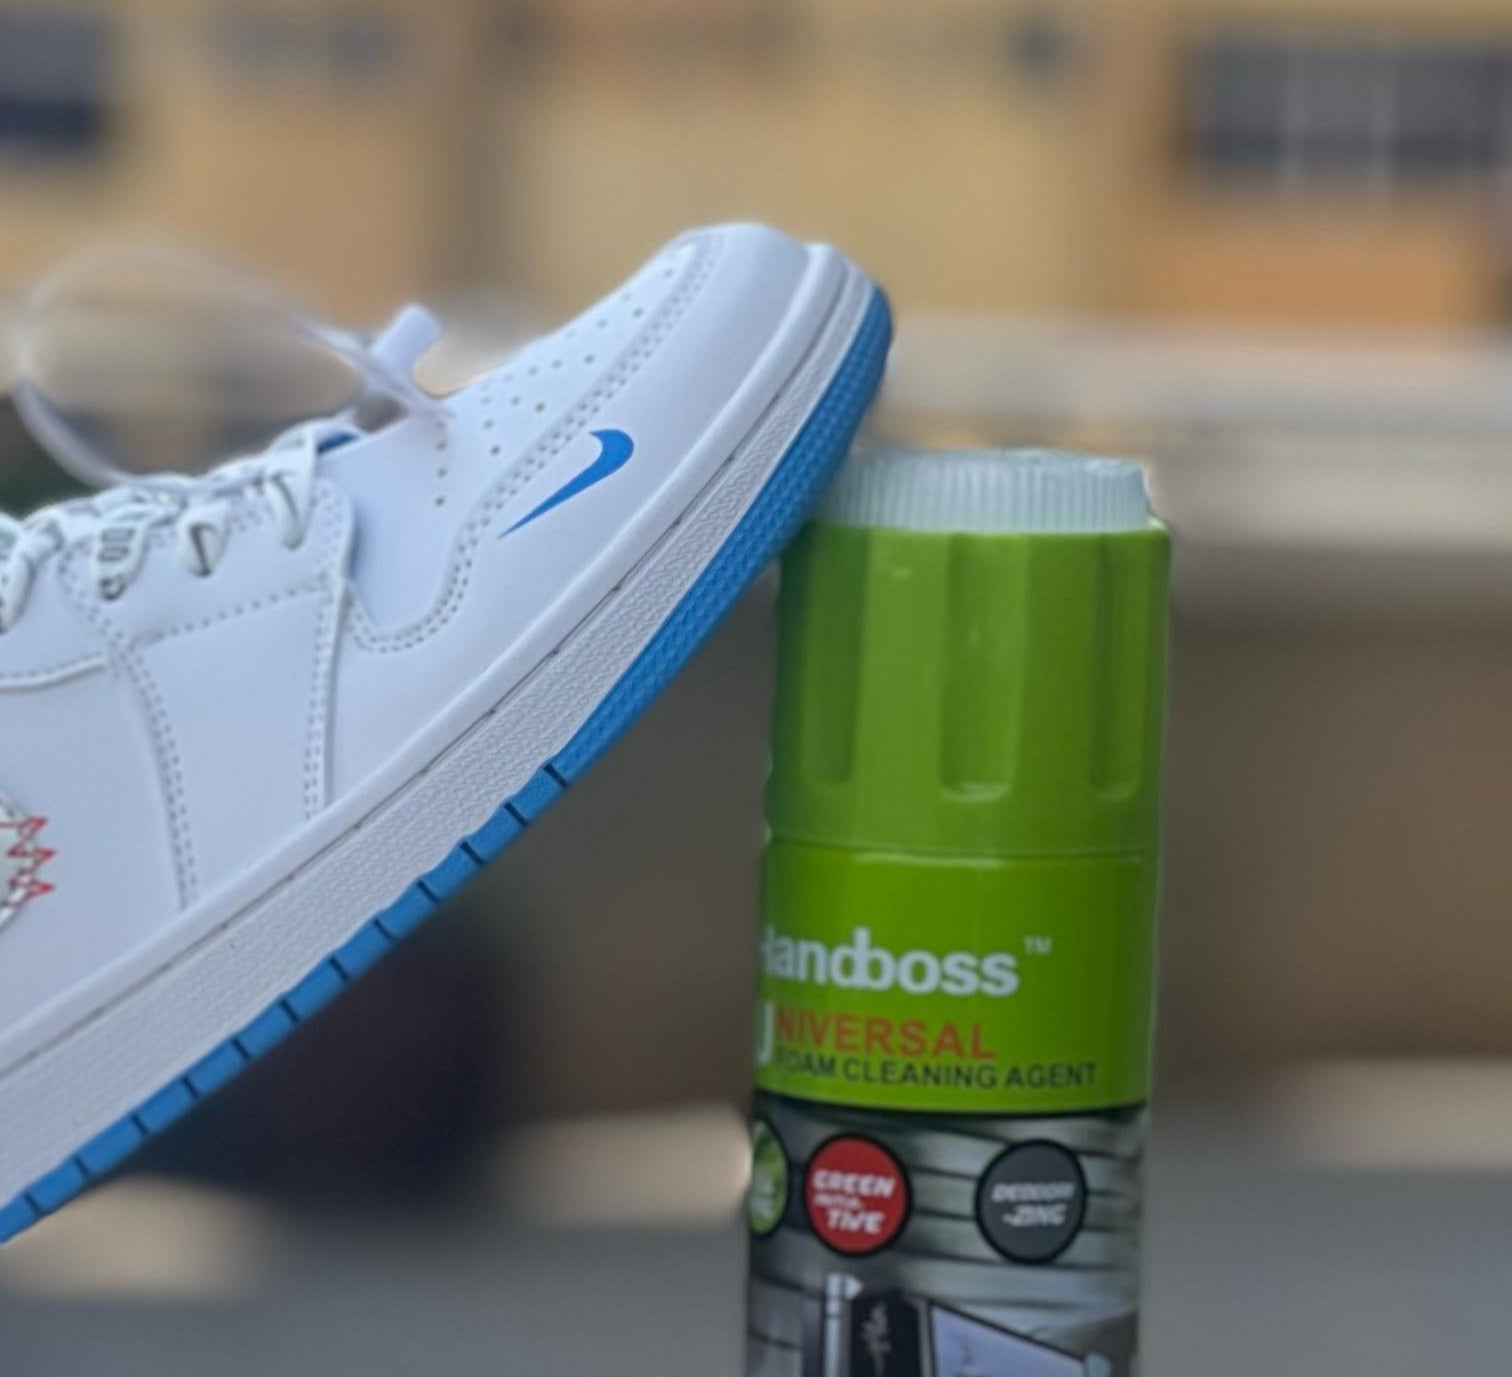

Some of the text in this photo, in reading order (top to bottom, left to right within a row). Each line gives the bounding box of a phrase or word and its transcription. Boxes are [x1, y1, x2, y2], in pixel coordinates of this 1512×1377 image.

[843, 1051, 998, 1090] CLEANING
[1005, 1061, 1098, 1089] AGENT
[812, 1168, 895, 1199] GREEN
